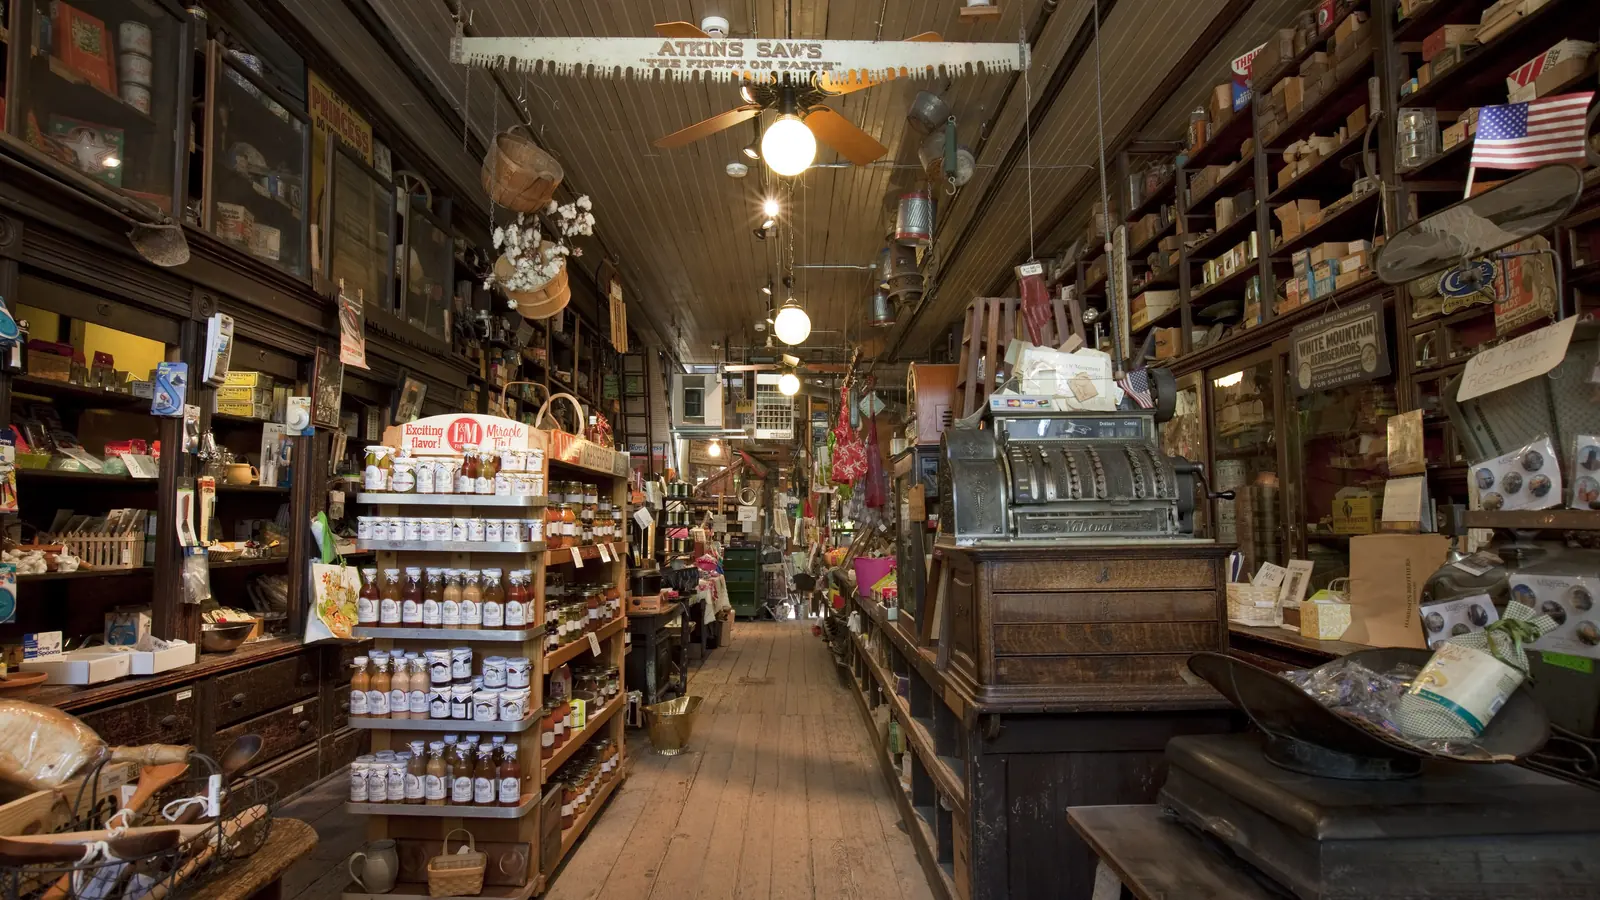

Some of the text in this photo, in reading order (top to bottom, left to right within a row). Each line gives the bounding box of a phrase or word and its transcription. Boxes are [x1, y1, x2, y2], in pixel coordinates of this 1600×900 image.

[657, 41, 823, 58] ATKINS SAWS
[686, 59, 746, 69] FINEST
[750, 60, 773, 69] ON
[311, 84, 370, 154] PRINCESS
[1349, 303, 1371, 314] HOMES
[1298, 319, 1375, 358] WHITE MOUNTAIN
[1310, 341, 1361, 366] REFRIGERATORS
[1313, 372, 1361, 388] FOR SALE HERE
[405, 424, 443, 436] Exciting
[453, 422, 478, 443] L&M
[486, 423, 523, 438] Miracle
[411, 437, 441, 449] flavor!
[1065, 519, 1113, 532] National
